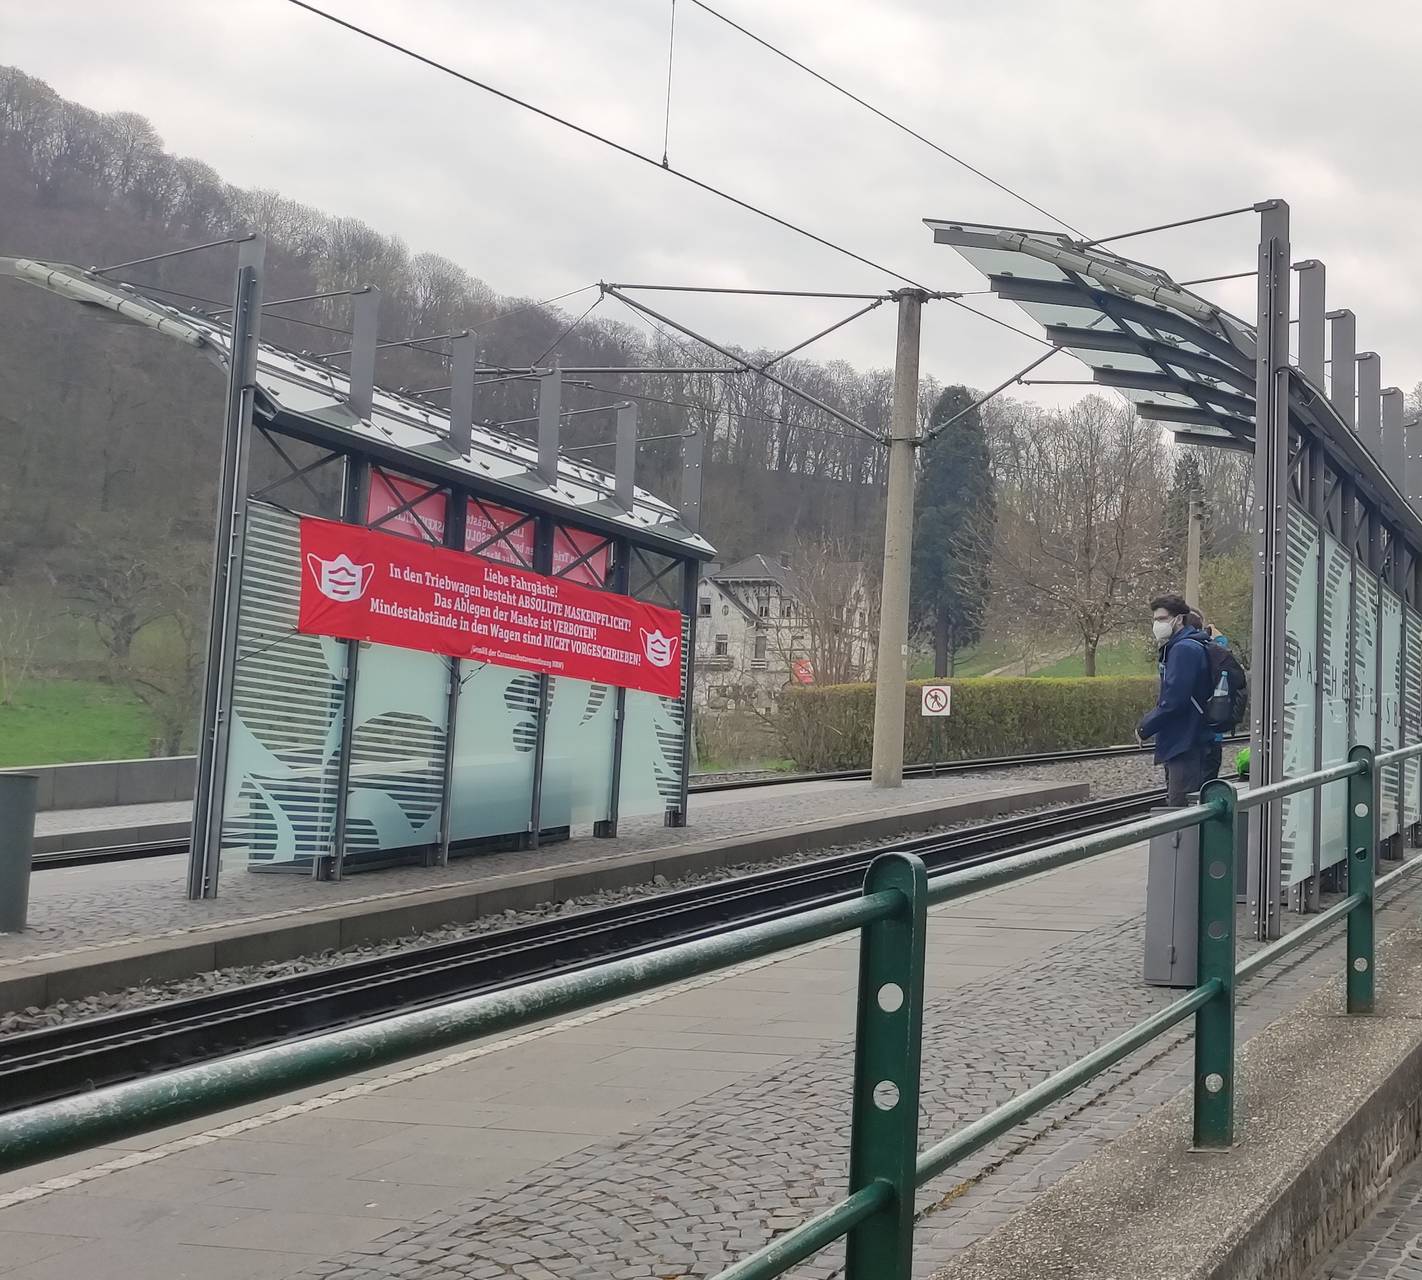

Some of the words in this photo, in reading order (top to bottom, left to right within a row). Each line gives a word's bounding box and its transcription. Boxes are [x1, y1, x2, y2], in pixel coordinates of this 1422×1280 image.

[390, 563, 401, 579] In
[403, 566, 423, 585] den
[425, 572, 481, 598] Triebwagen
[483, 585, 517, 606] besteht
[518, 595, 563, 617] ABSOLUTE
[564, 605, 631, 632] MASKENPFLICHT!
[484, 568, 508, 586] Liebe
[510, 575, 558, 598] Fahrgäste!
[370, 598, 458, 629] Mindestabstände
[460, 617, 470, 631] in
[471, 620, 489, 636] den
[490, 623, 521, 643] Wagen
[522, 631, 543, 647] sind
[544, 635, 570, 652] NICHT
[571, 640, 641, 667] VORGESCHRIEBEN!
[434, 593, 452, 609] Das
[454, 597, 491, 618] Ablegen
[493, 606, 509, 620] der
[510, 610, 539, 629] Maske
[540, 616, 552, 630] ist
[553, 619, 597, 640] VERBOTEN!
